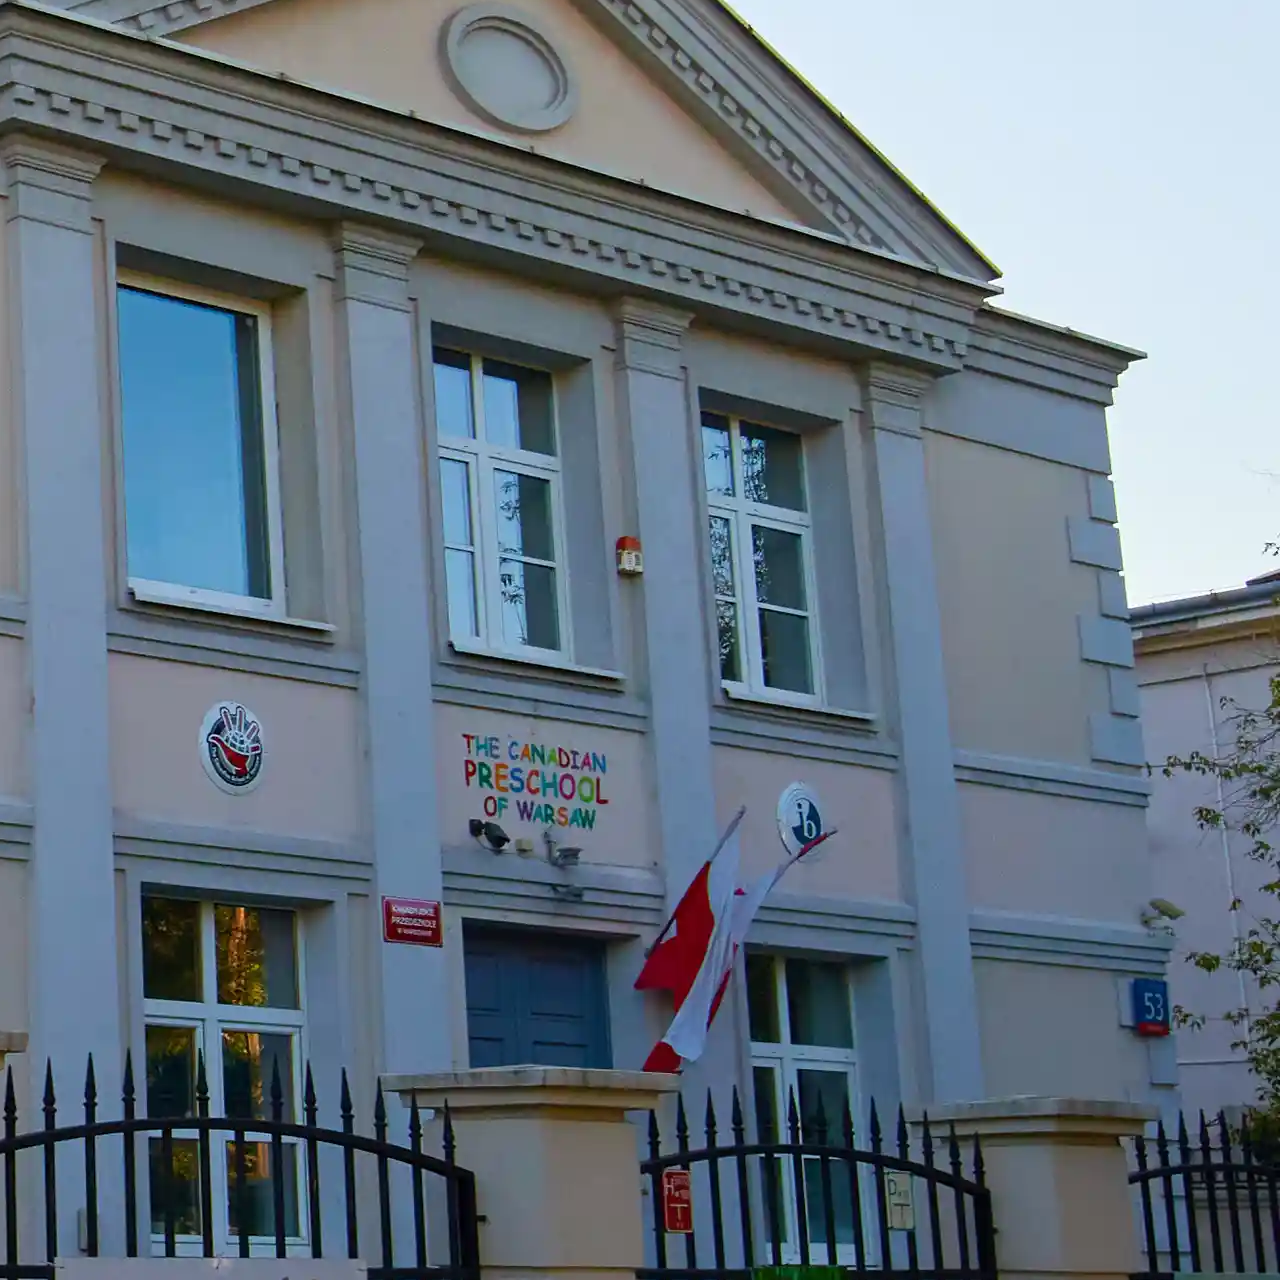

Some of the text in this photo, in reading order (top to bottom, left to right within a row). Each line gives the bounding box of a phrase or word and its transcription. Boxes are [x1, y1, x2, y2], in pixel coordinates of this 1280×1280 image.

[462, 733, 606, 774] THE CANADIAN
[464, 759, 609, 804] PRESCHOOL
[484, 795, 596, 830] OF WARSAW
[1144, 992, 1164, 1021] 53
